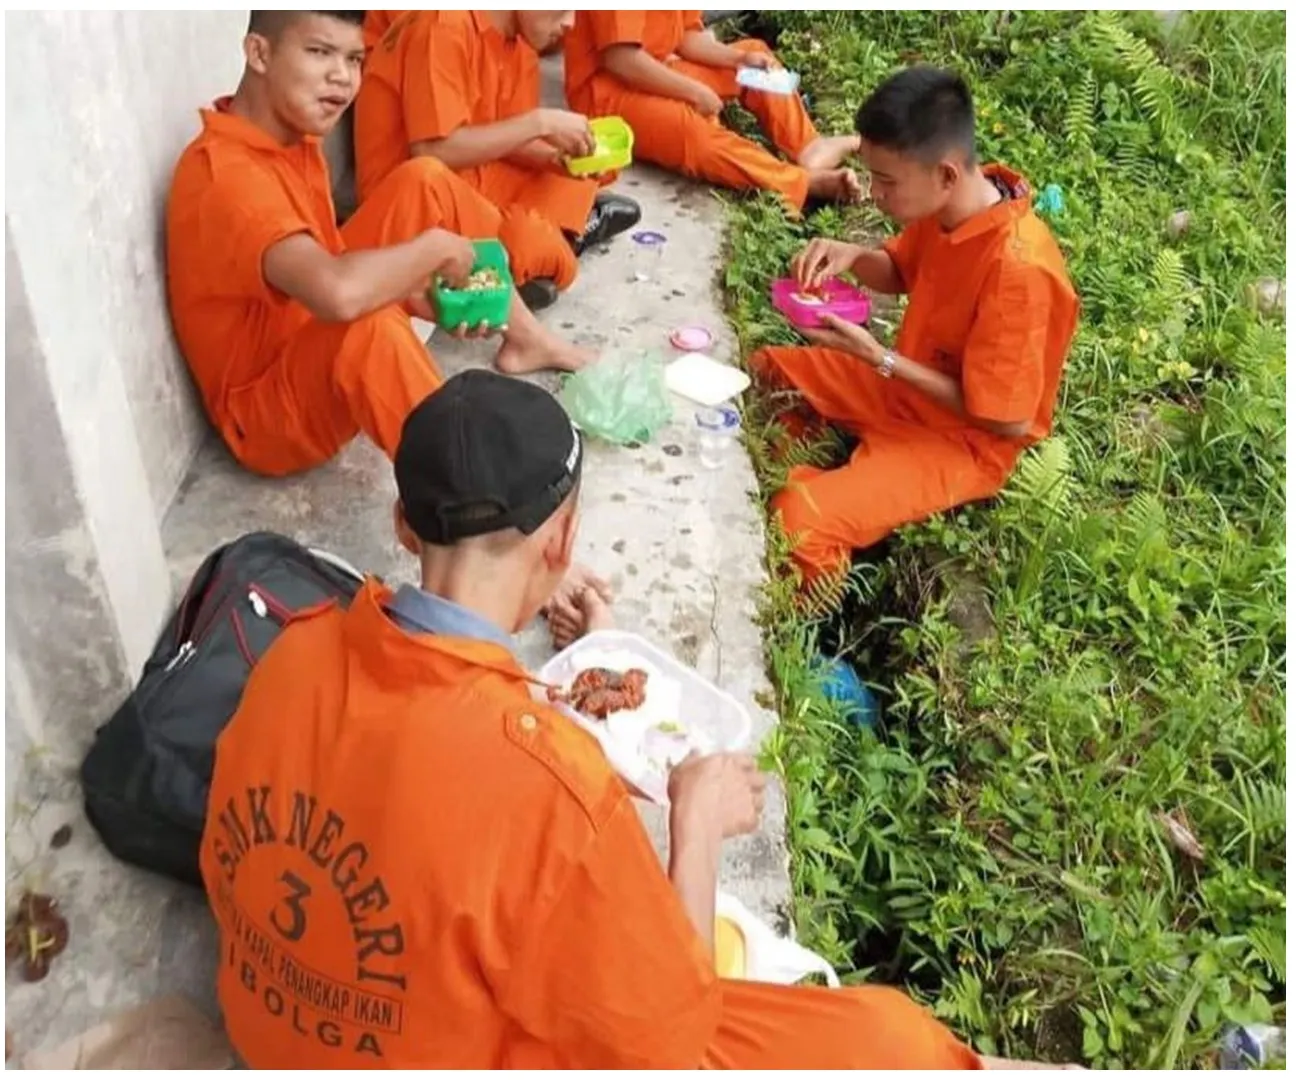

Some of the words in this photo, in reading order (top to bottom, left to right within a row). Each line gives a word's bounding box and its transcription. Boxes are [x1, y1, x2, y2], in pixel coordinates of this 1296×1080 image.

[270, 869, 311, 941] 3
[285, 790, 407, 991] NEGERI
[228, 941, 383, 1057] IBOLGA
[278, 954, 350, 1016] PENANGKAP
[354, 991, 393, 1028] IKAN
